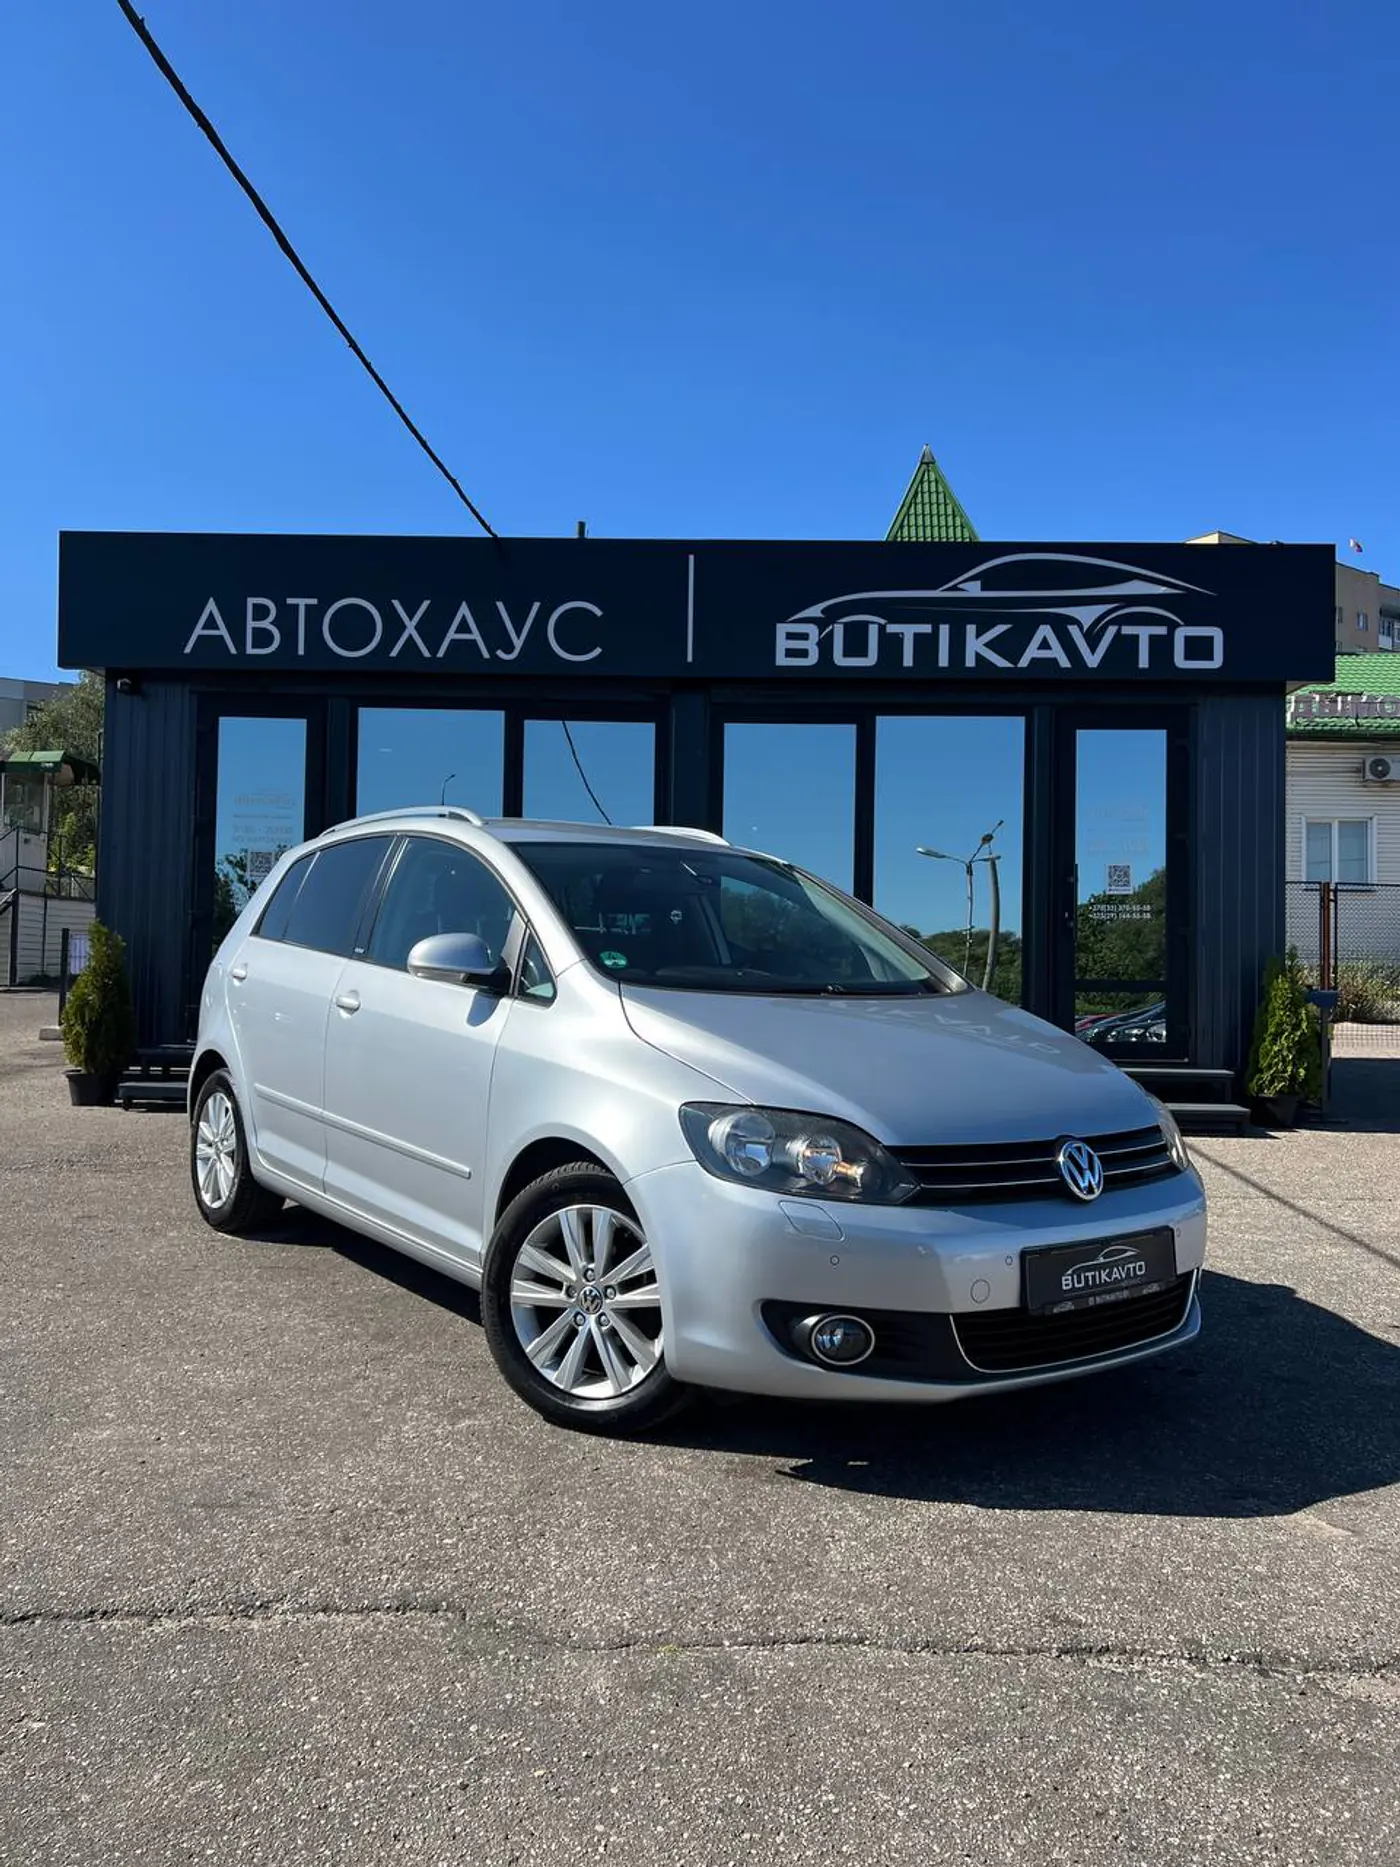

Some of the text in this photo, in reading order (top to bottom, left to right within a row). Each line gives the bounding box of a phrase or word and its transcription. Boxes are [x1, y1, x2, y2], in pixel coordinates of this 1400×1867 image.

[183, 596, 604, 663] АВТОХАУС
[775, 622, 1225, 670] BUTIKAVTO
[1060, 1141, 1104, 1200] VW
[1061, 1261, 1146, 1291] BUTIKAVTO
